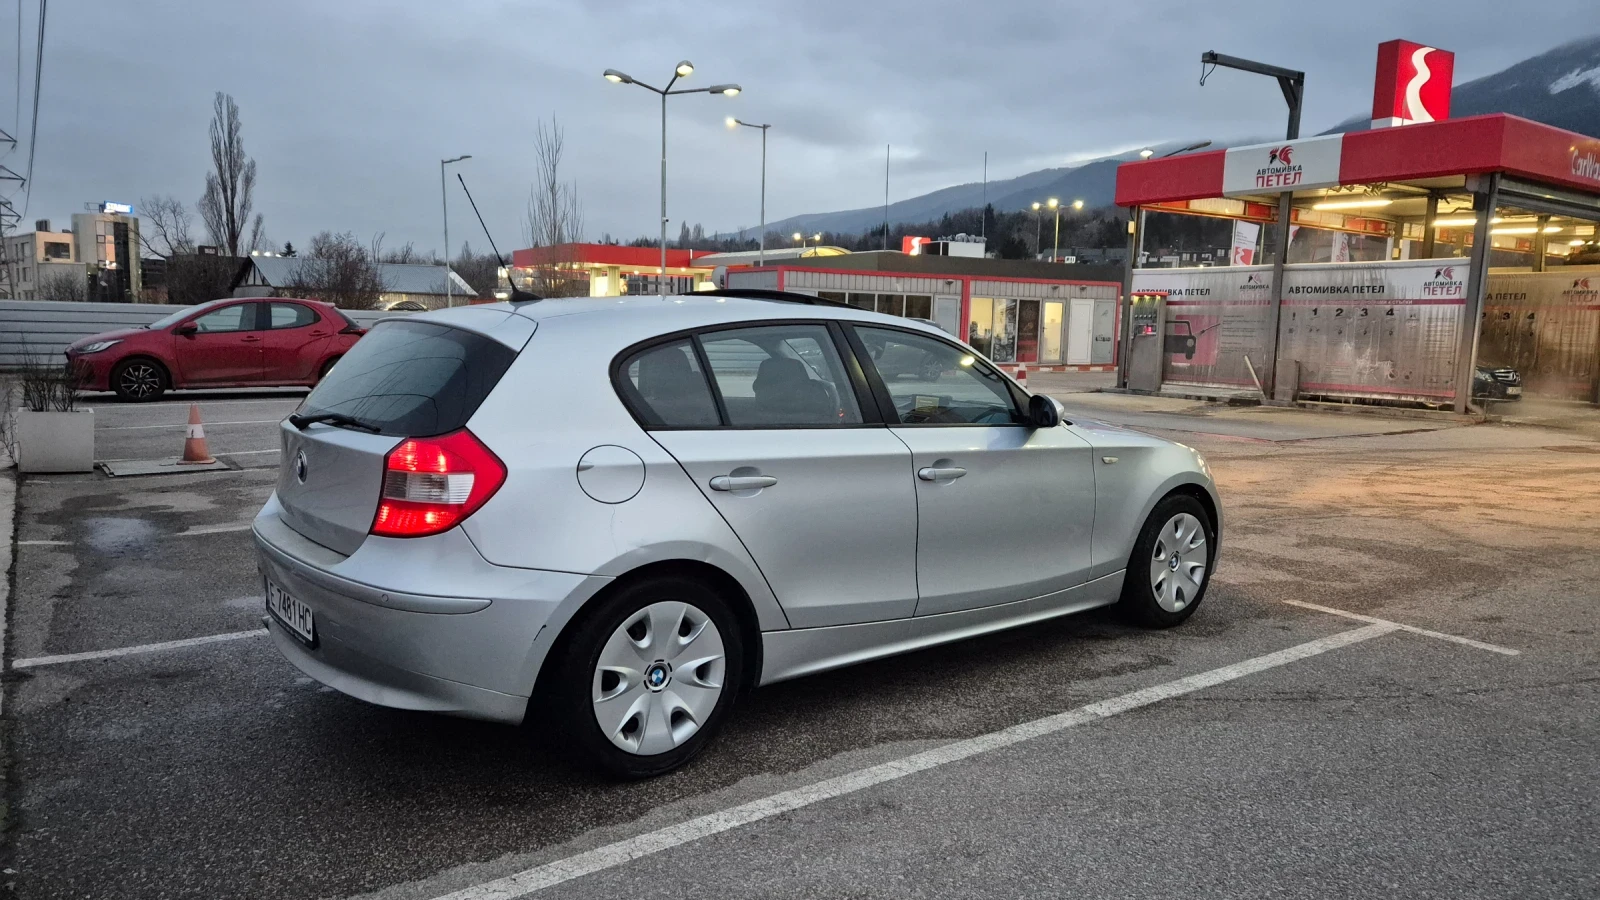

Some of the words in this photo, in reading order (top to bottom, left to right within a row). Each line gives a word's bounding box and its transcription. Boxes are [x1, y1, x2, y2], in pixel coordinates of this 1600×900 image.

[1572, 149, 1600, 179] CarWa
[1256, 164, 1303, 176] АВТОМИВКА
[1256, 171, 1303, 188] ПЕТЕЛ
[1184, 288, 1211, 296] ПЕТЕЛ
[1288, 286, 1350, 294] АВТОМИВКА
[1352, 285, 1385, 294] ПЕТЕЛ
[1423, 286, 1462, 296] ПЕТЕЛ
[1495, 292, 1527, 301] ПЕТЕЛ
[1312, 308, 1318, 316] 1
[1335, 308, 1343, 317] 2
[1360, 308, 1368, 317] 3
[1386, 308, 1394, 316] 4
[1503, 312, 1510, 320] 3
[1526, 312, 1535, 320] 4
[269, 582, 275, 607] E
[277, 588, 297, 625] 7481
[298, 602, 311, 635] HC
